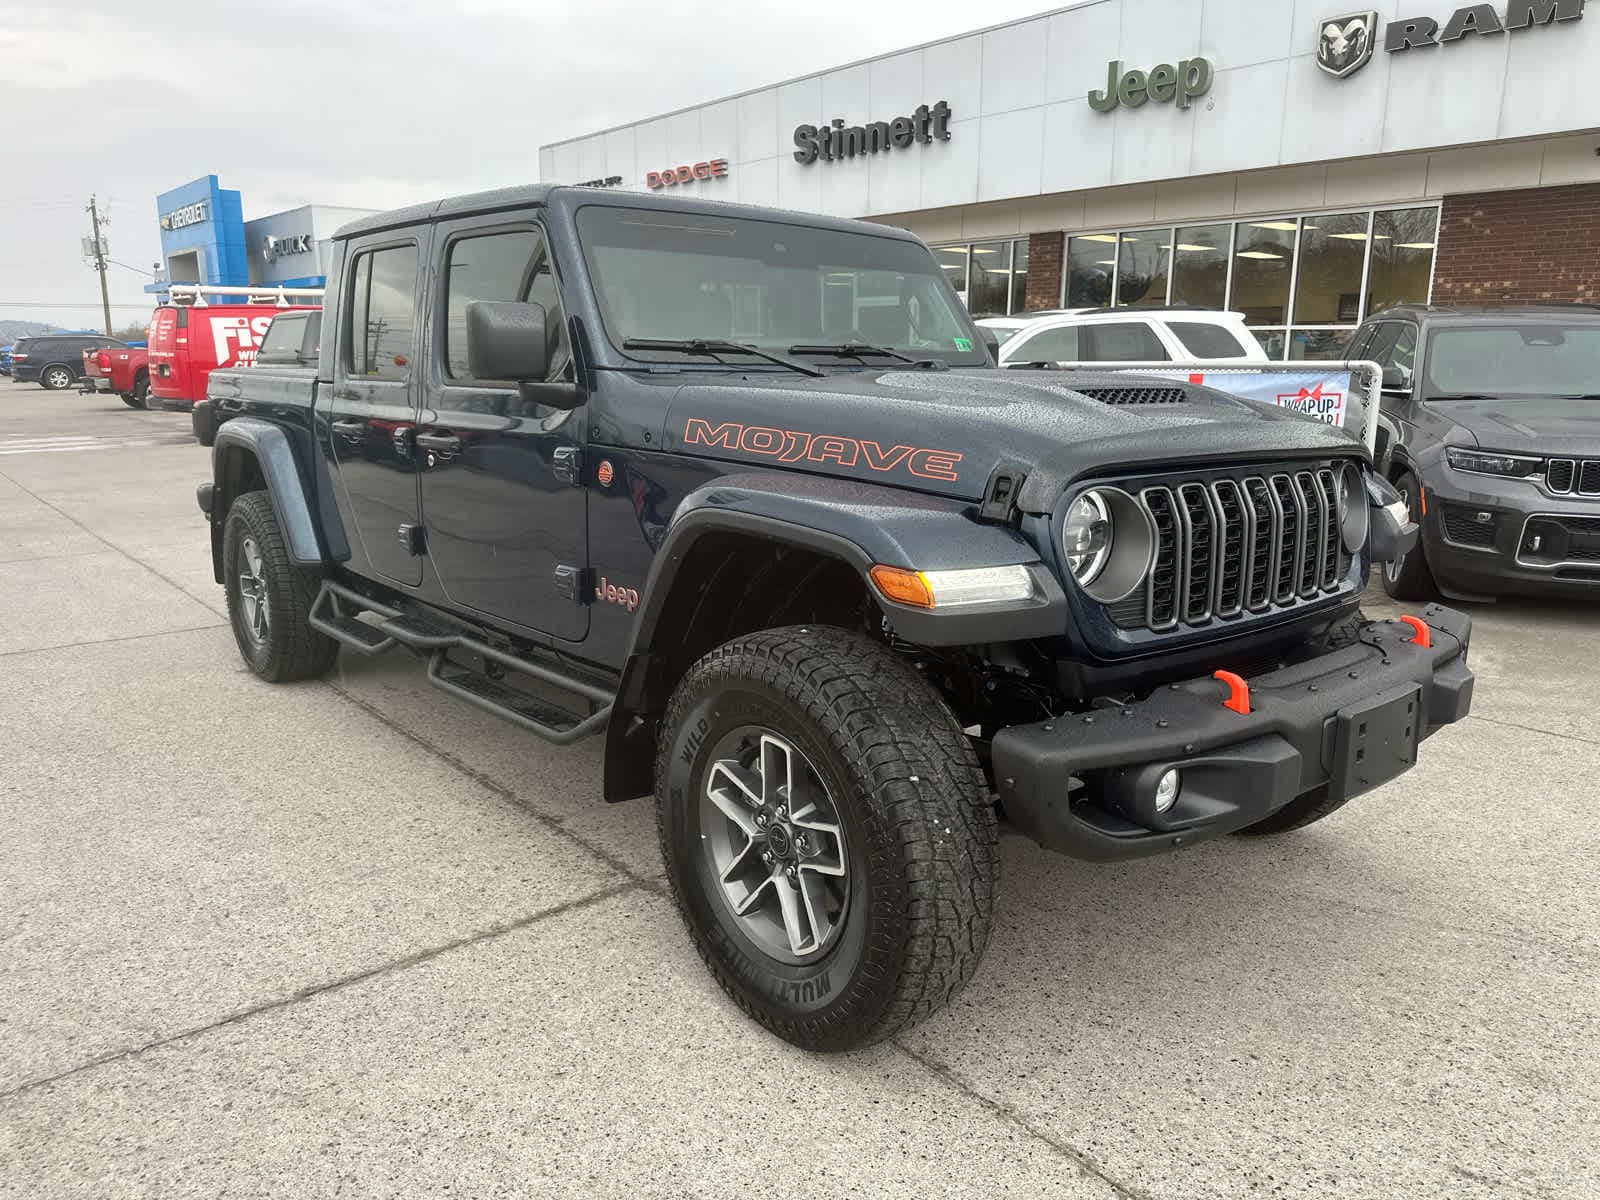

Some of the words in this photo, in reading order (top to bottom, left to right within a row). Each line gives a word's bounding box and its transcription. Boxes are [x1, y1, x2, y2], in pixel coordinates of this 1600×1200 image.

[1384, 0, 1582, 53] RAM
[1088, 57, 1213, 112] Jeep
[793, 100, 951, 164] Stinnett
[646, 158, 728, 189] DODGE
[171, 202, 205, 228] CHEVROLET
[274, 234, 309, 257] BUICK
[1317, 399, 1334, 414] UP
[684, 418, 963, 481] MOJAVE
[595, 577, 640, 612] Jeep
[680, 718, 709, 764] WILD
